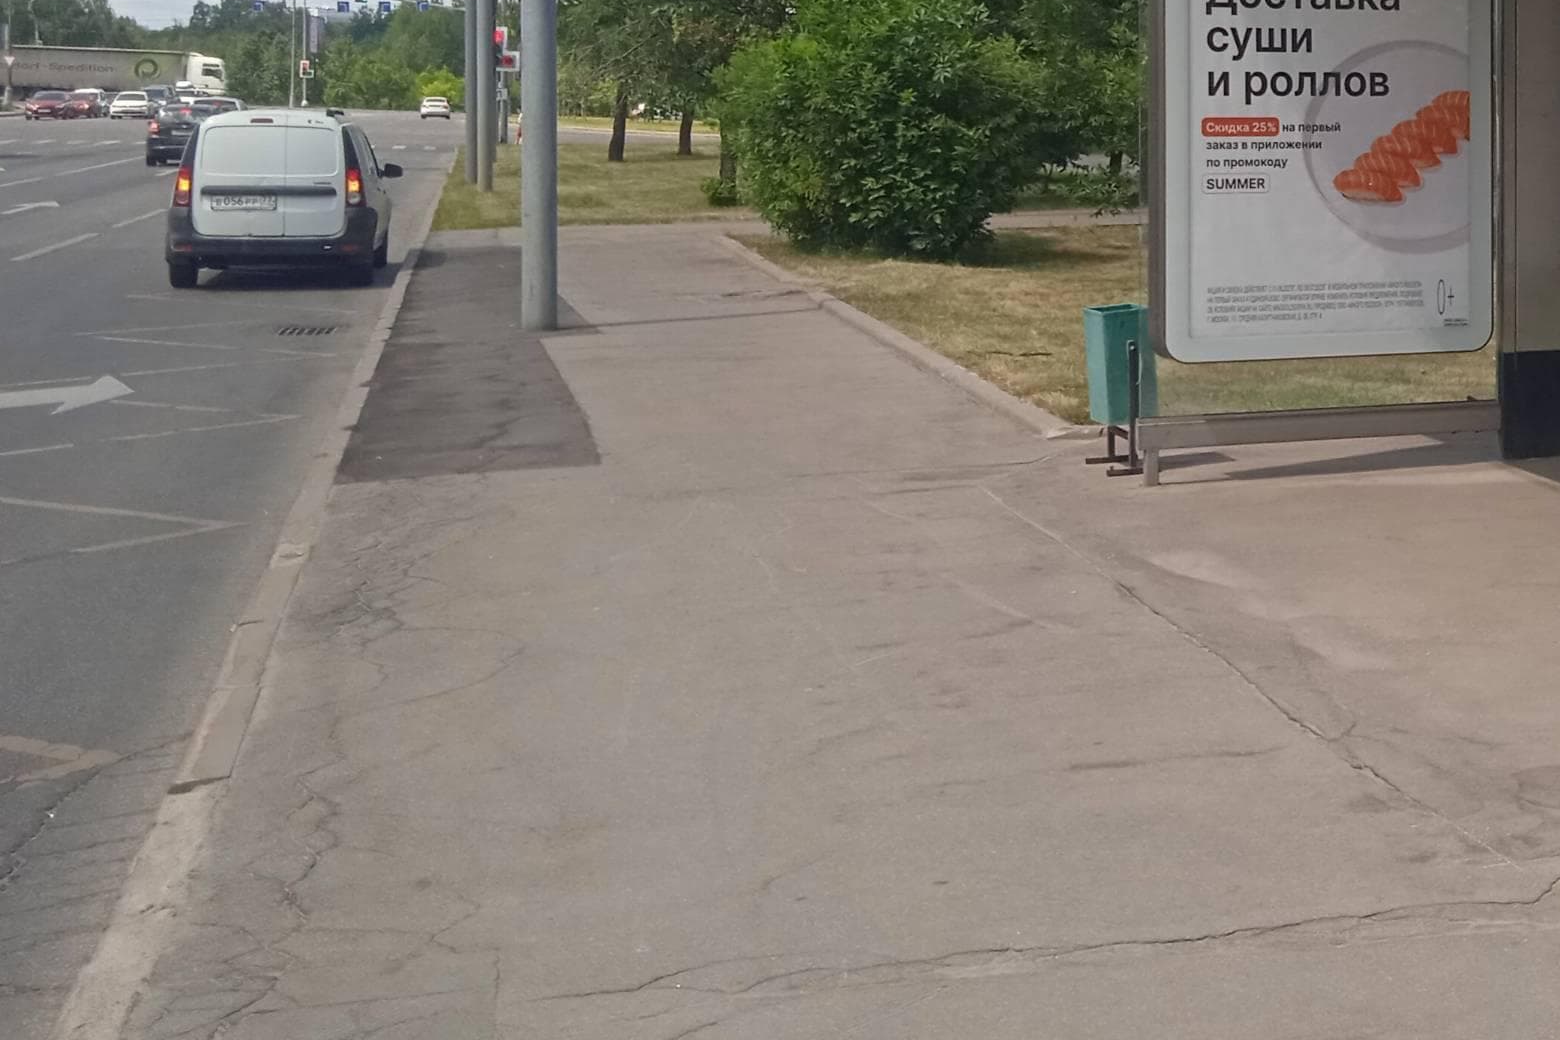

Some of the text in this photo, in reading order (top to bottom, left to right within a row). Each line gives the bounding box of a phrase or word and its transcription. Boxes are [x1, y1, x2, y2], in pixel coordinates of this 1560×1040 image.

[1206, 26, 1313, 61] суши
[1207, 71, 1390, 105] и роллов
[1206, 121, 1341, 135] Скидка 25% на первый
[1206, 140, 1322, 152] заказ в приложении
[1206, 158, 1288, 170] по промокоду
[1206, 178, 1265, 191] SUMMER
